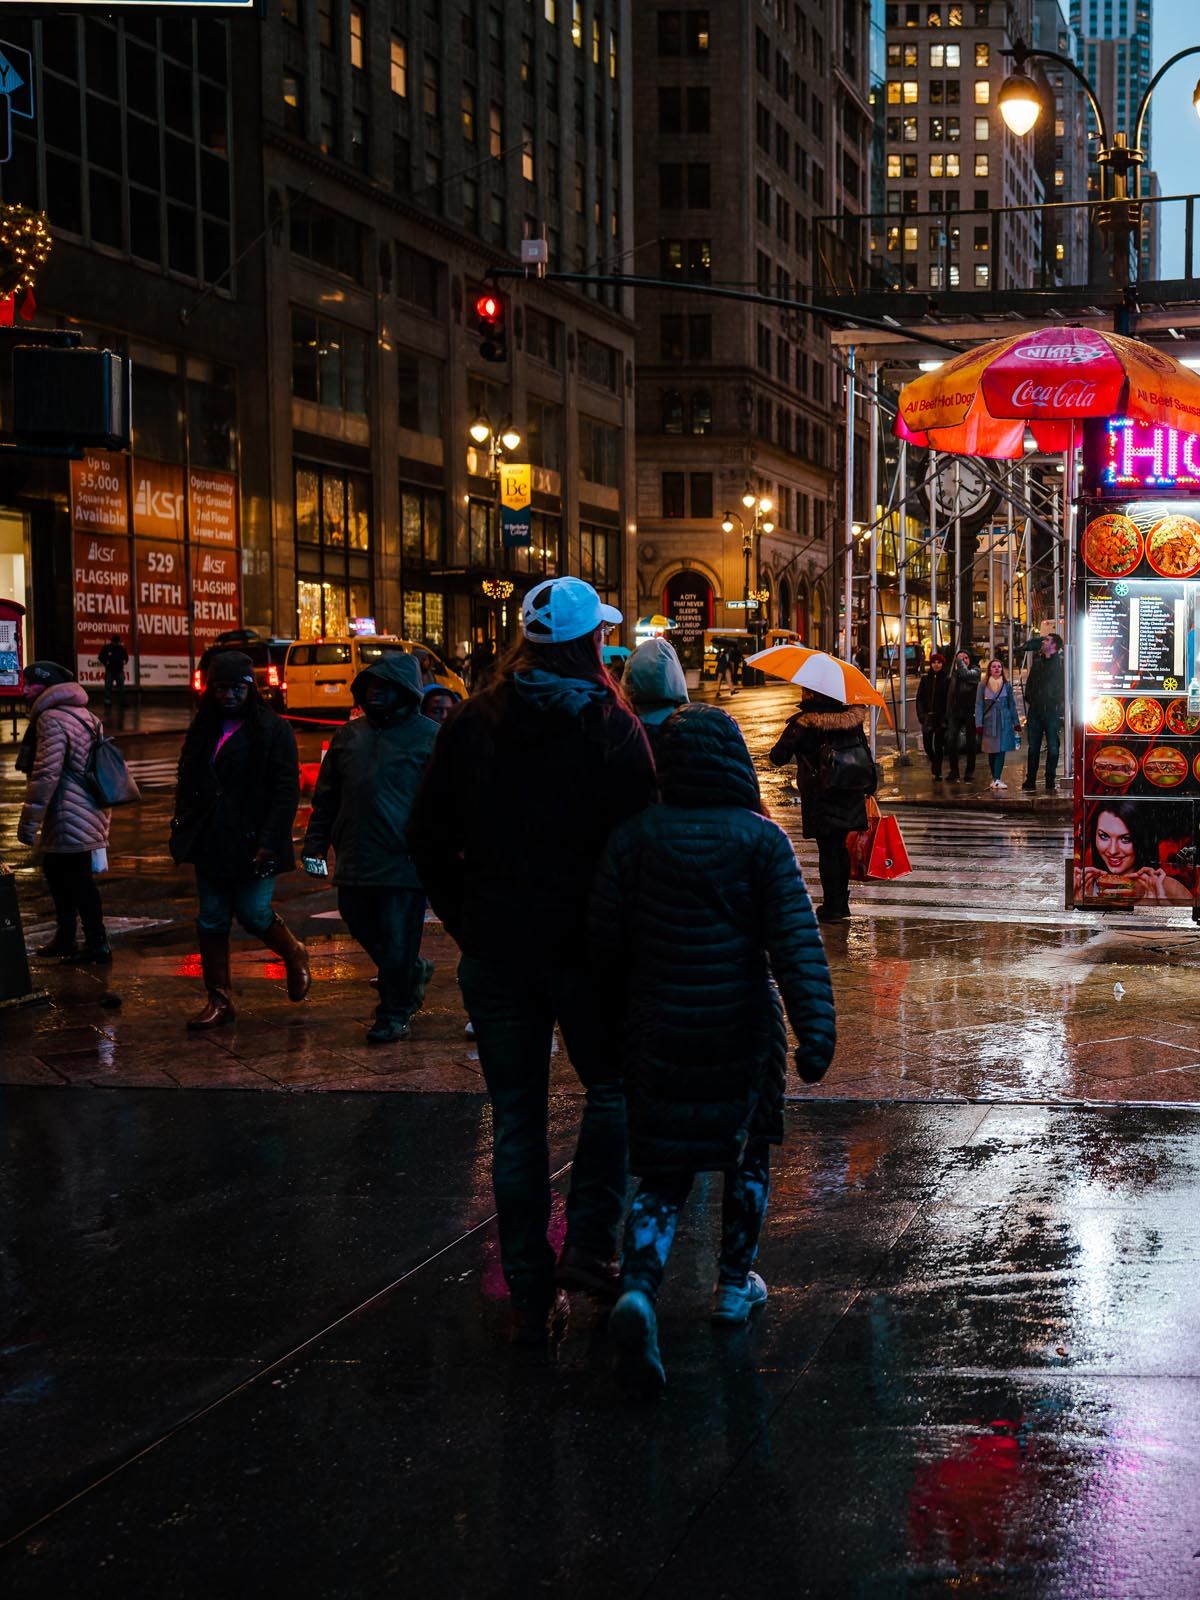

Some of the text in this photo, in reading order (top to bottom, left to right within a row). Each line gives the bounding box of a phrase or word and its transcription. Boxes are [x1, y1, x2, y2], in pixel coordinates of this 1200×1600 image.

[905, 401, 917, 414] All
[919, 398, 937, 412] Beef
[956, 392, 976, 407] Dogs
[1149, 393, 1173, 408] Beef
[87, 456, 111, 471] Up to
[80, 471, 119, 492] 35,000
[190, 475, 235, 495] Opportunity
[505, 478, 527, 497] Be
[76, 505, 126, 527] Available
[147, 552, 174, 573] 529
[76, 568, 129, 587] FLAGSHIP
[192, 579, 236, 596] FLAGSHIP
[76, 592, 129, 615] RETAIL
[141, 582, 182, 605] FIFTH
[193, 601, 237, 622] RETAIL
[77, 622, 129, 633] OPPORTUNITY
[137, 614, 189, 636] AVENUE
